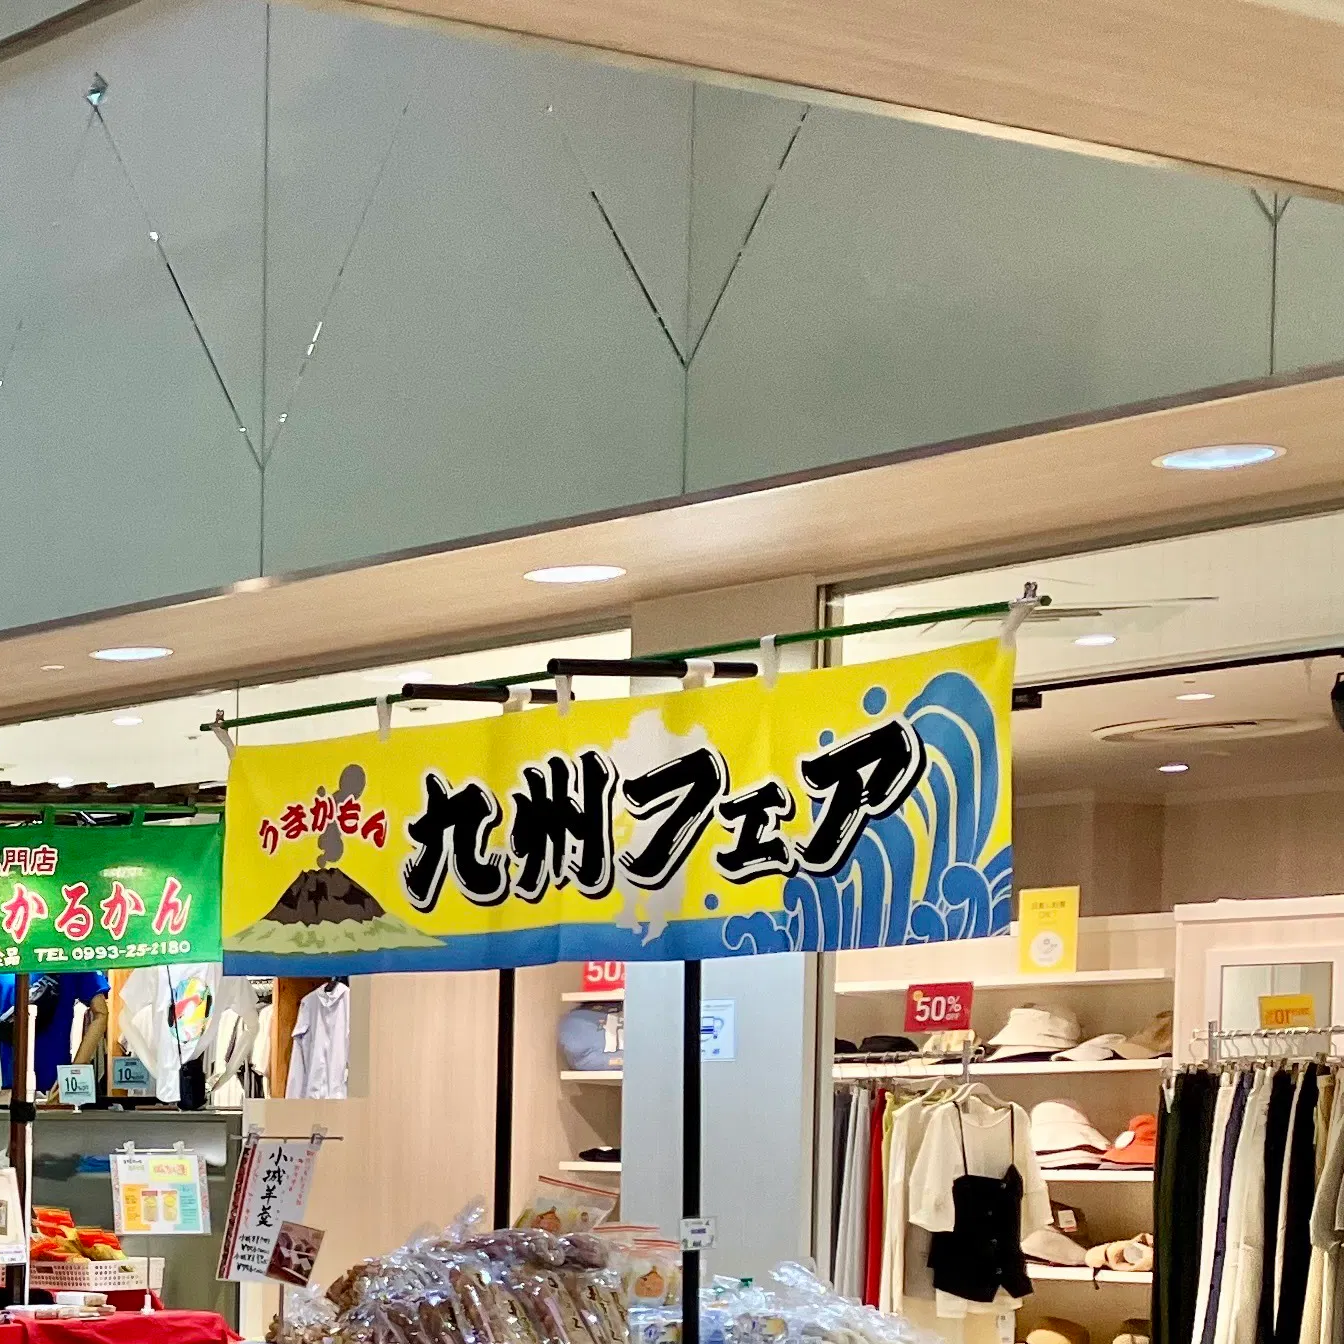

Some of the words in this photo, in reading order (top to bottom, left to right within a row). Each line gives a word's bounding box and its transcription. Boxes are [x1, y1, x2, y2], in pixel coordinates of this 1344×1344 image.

[258, 797, 388, 857] うまかもん
[404, 719, 927, 915] 九州フェア
[1, 876, 191, 943] かるかん
[34, 947, 69, 962] TEL
[72, 940, 191, 960] 0993-25-2180
[587, 961, 624, 982] 50
[915, 996, 962, 1022] 50%
